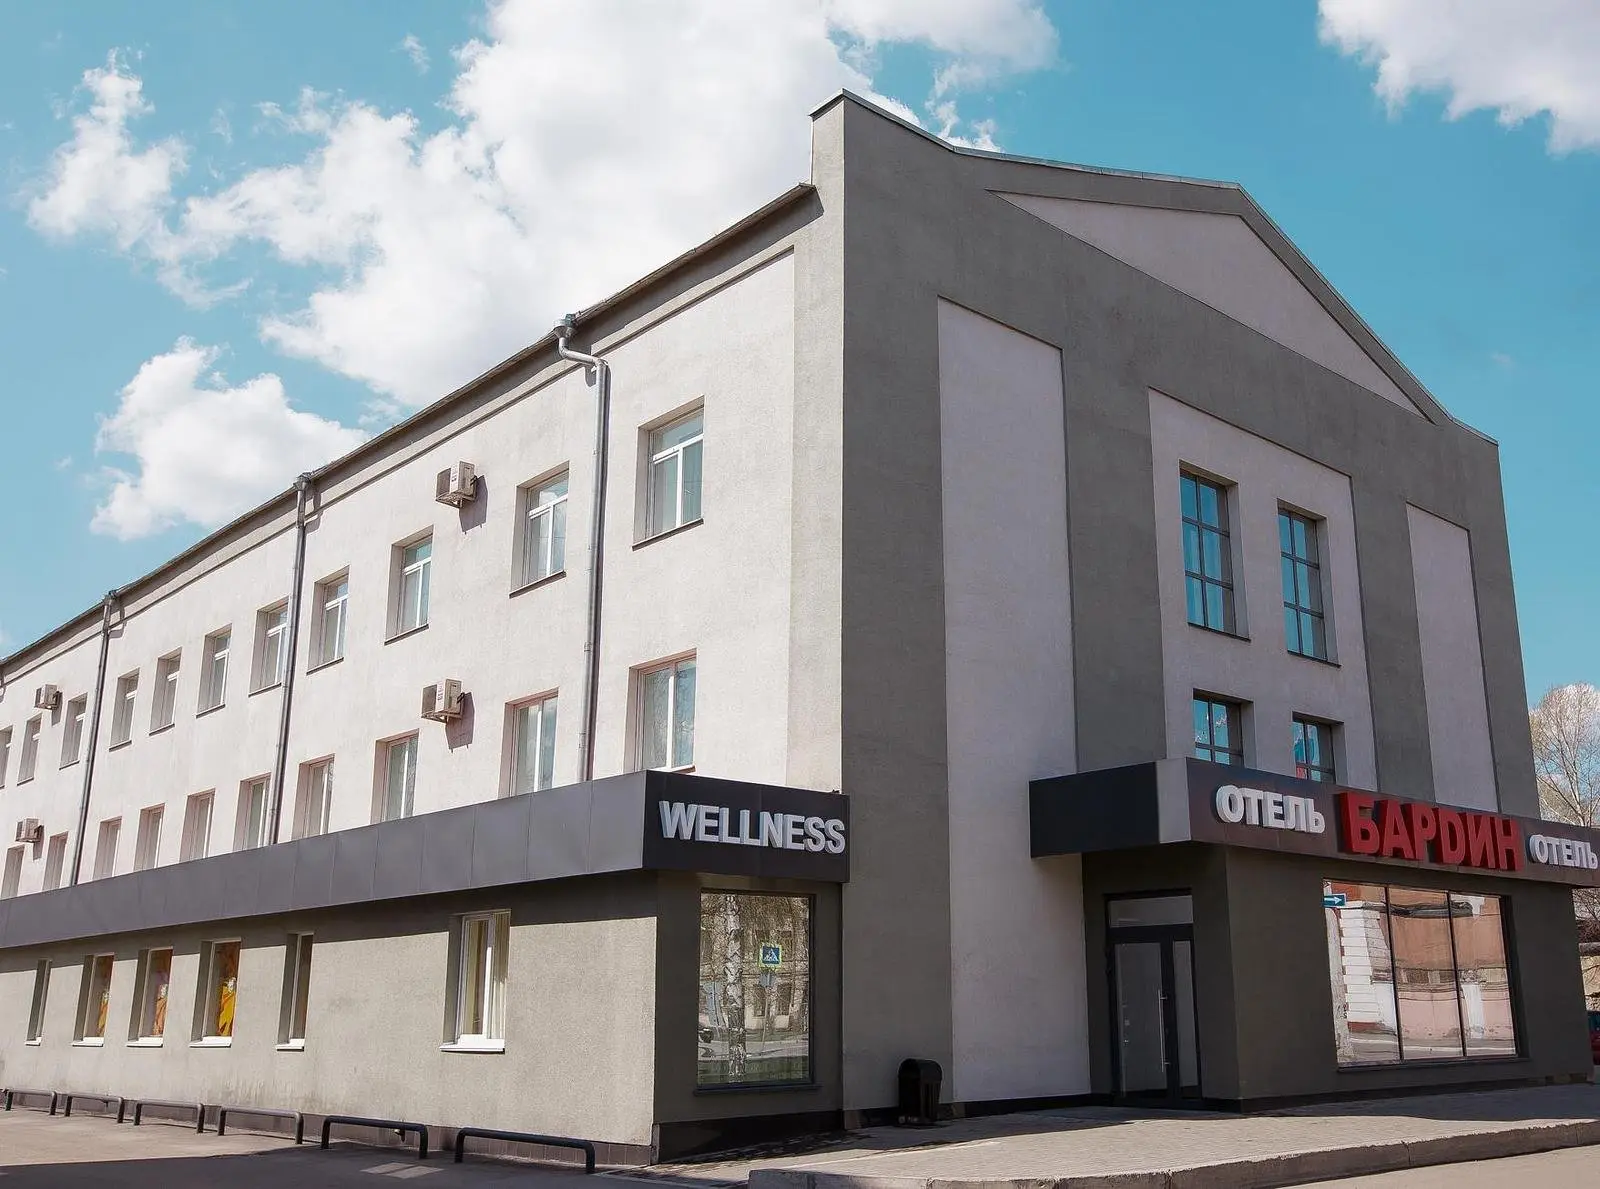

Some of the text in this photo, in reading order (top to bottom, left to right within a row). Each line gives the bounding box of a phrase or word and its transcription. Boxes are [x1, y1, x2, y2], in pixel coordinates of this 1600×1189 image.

[658, 800, 846, 853] WELLNESS
[1216, 784, 1326, 834] ОТЕЛЬ
[1529, 834, 1598, 870] ОТЕЛЬ
